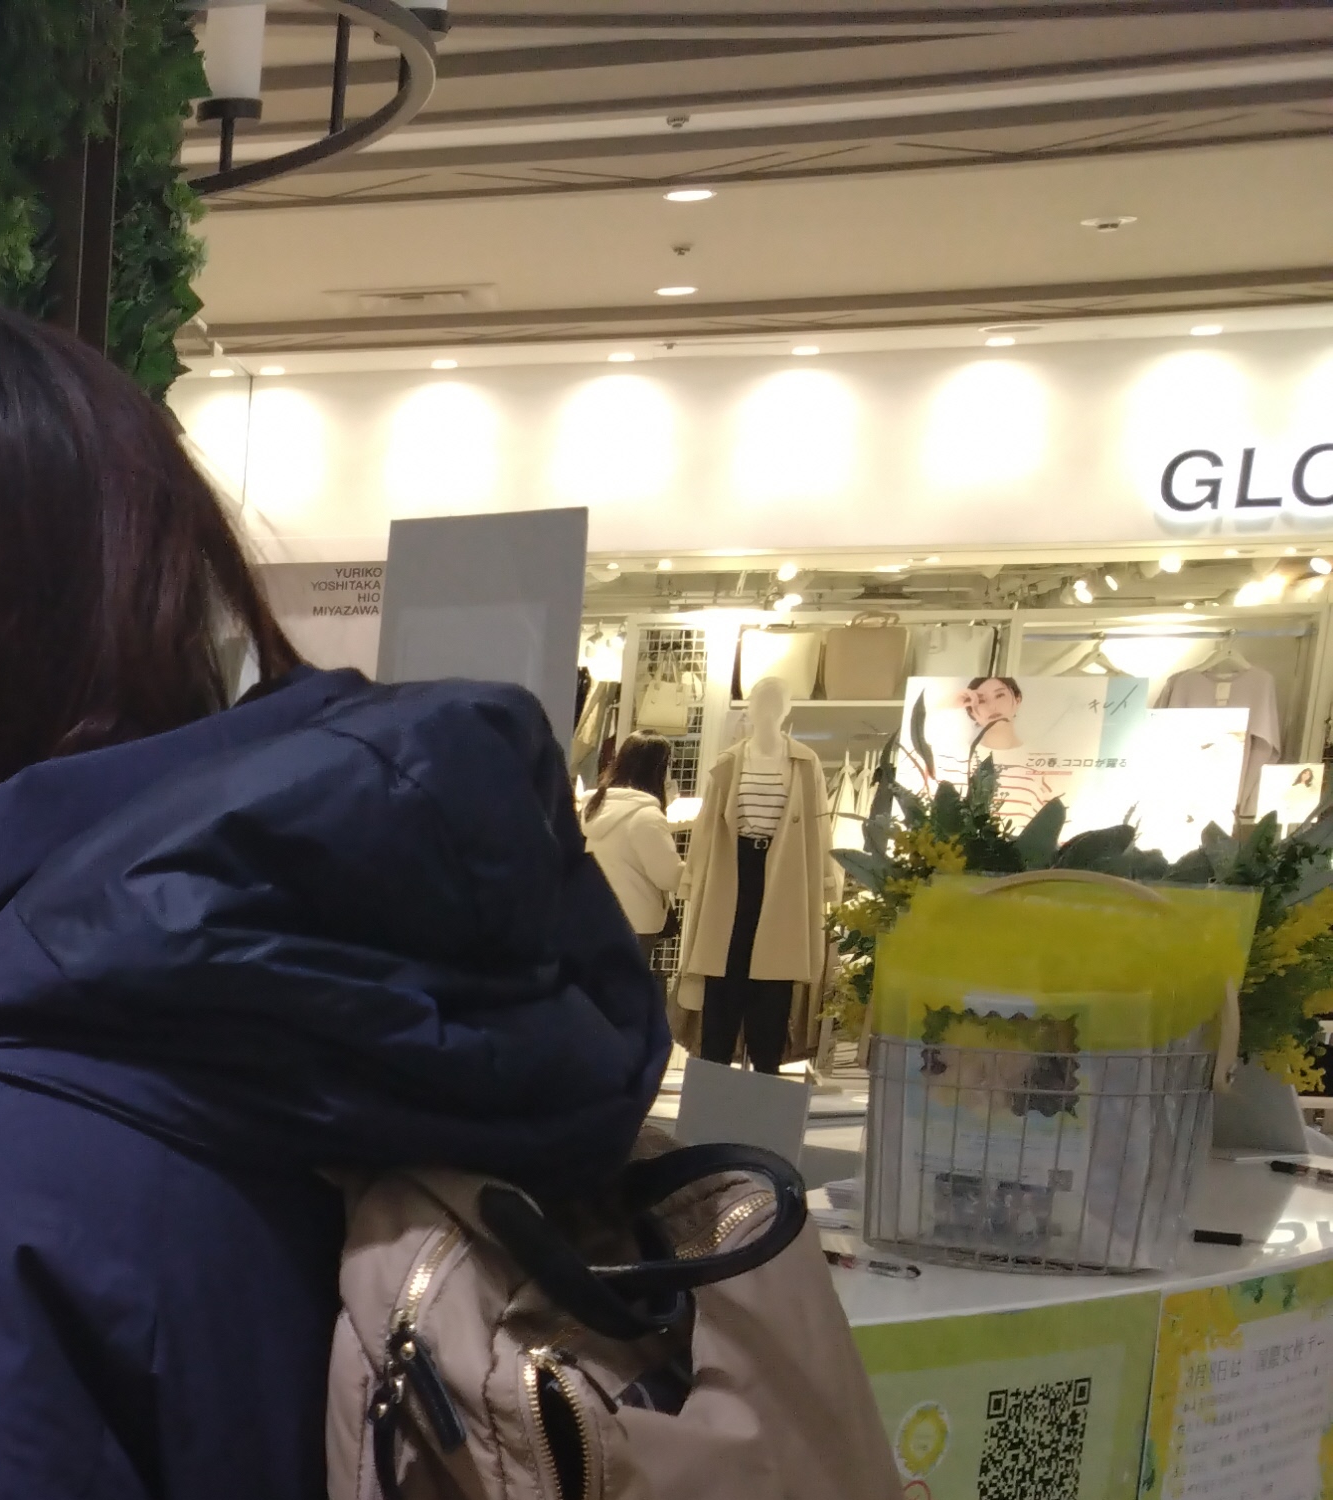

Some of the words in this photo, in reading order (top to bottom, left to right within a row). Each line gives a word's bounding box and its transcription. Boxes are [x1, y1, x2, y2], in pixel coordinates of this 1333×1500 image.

[335, 567, 383, 579] YURIKO
[311, 580, 381, 592] YOSHITAKA
[357, 592, 381, 603] HIO
[312, 605, 380, 617] MIYAZAWA
